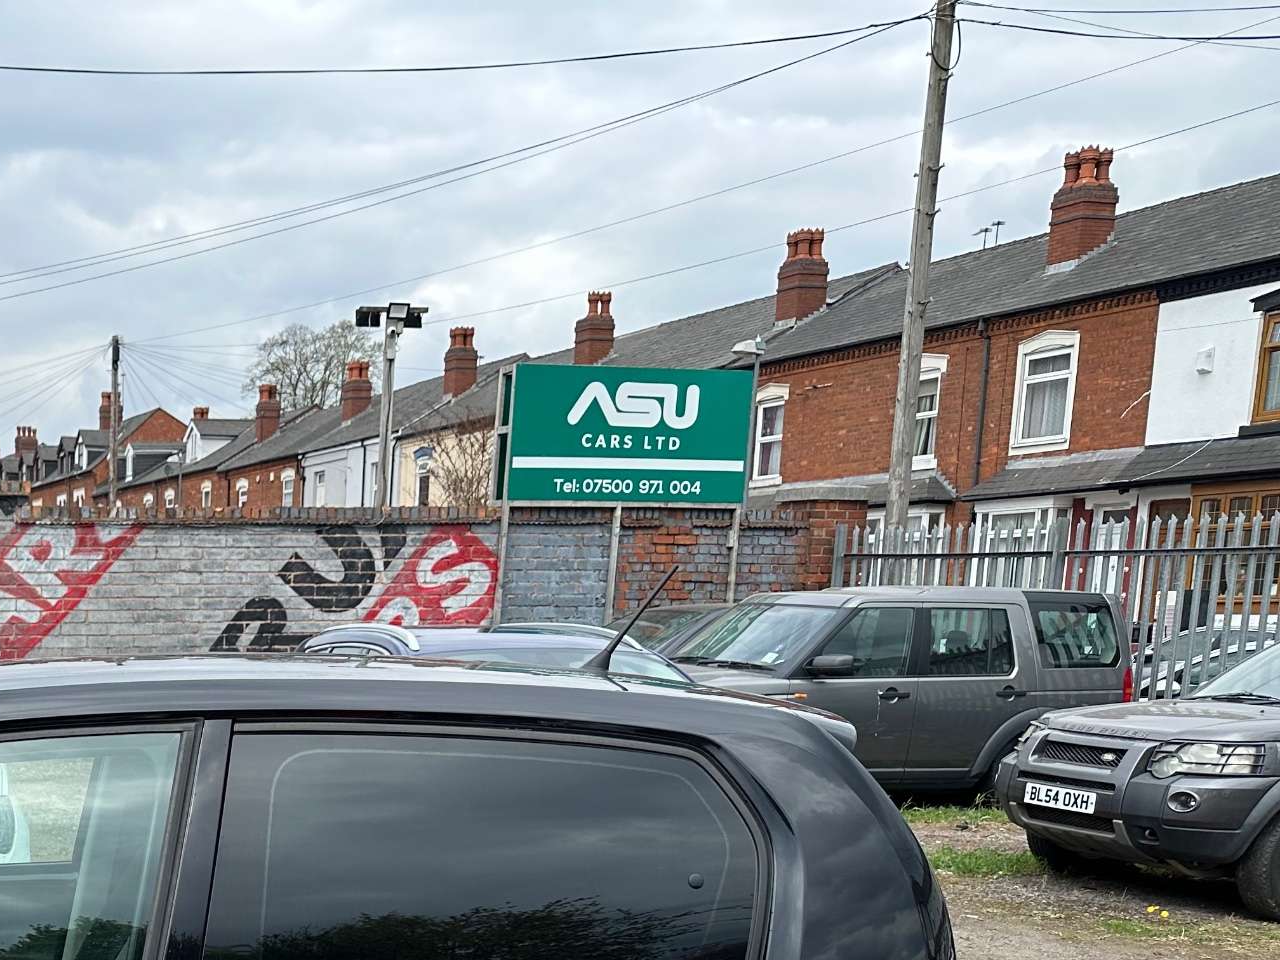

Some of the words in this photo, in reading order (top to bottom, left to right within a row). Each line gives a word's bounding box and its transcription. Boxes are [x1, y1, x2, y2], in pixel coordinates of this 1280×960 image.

[567, 381, 700, 430] ASU
[581, 433, 633, 449] CARS
[643, 436, 681, 450] LTD
[553, 478, 580, 493] Tel:
[582, 479, 634, 494] 07500
[638, 480, 664, 495] 971
[669, 481, 702, 495] 004
[1029, 785, 1060, 805] BL54
[1063, 791, 1090, 810] OXH
